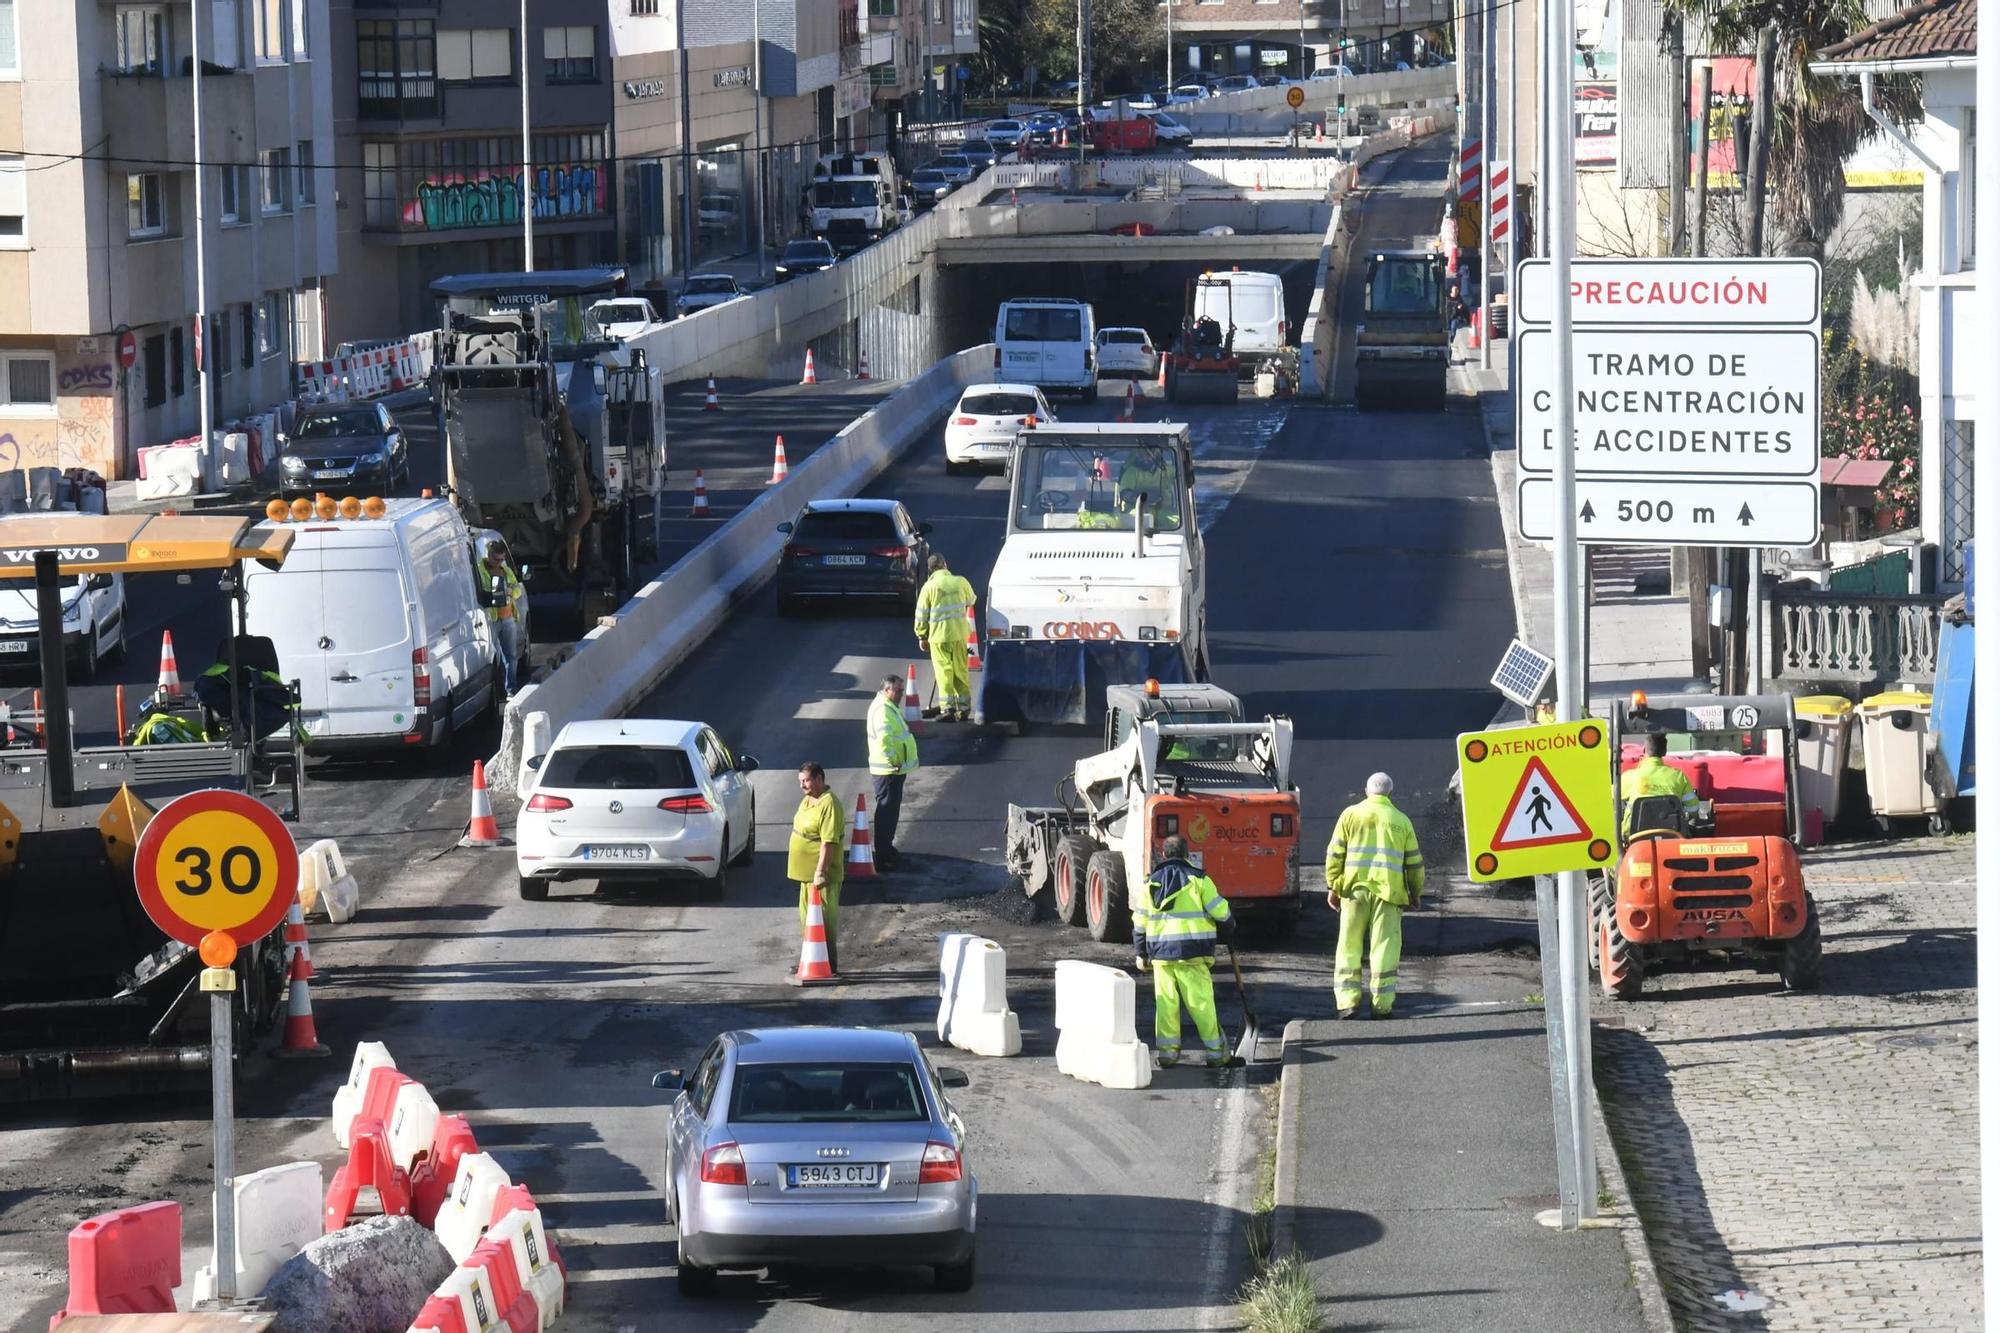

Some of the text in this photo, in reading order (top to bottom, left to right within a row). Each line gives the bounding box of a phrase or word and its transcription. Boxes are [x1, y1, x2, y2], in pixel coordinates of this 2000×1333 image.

[497, 294, 549, 304] WIRTGEN
[1571, 276, 1767, 305] PRECAUCIÓN
[1588, 353, 1747, 377] TRAMO DE
[1533, 386, 1804, 415] CNCENTRACIÓN
[1593, 430, 1792, 454] ACCIDENTES
[1617, 499, 1716, 524] 500 m
[3, 547, 100, 563] VOVO
[1042, 622, 1127, 640] CORINSA
[1736, 707, 1754, 727] 25
[1491, 733, 1577, 757] ATENCIÓN
[591, 847, 644, 858] 9704 KLS
[175, 845, 262, 896] 30
[1682, 910, 1746, 921] AUSA
[801, 1166, 875, 1182] 5943 CTJ
